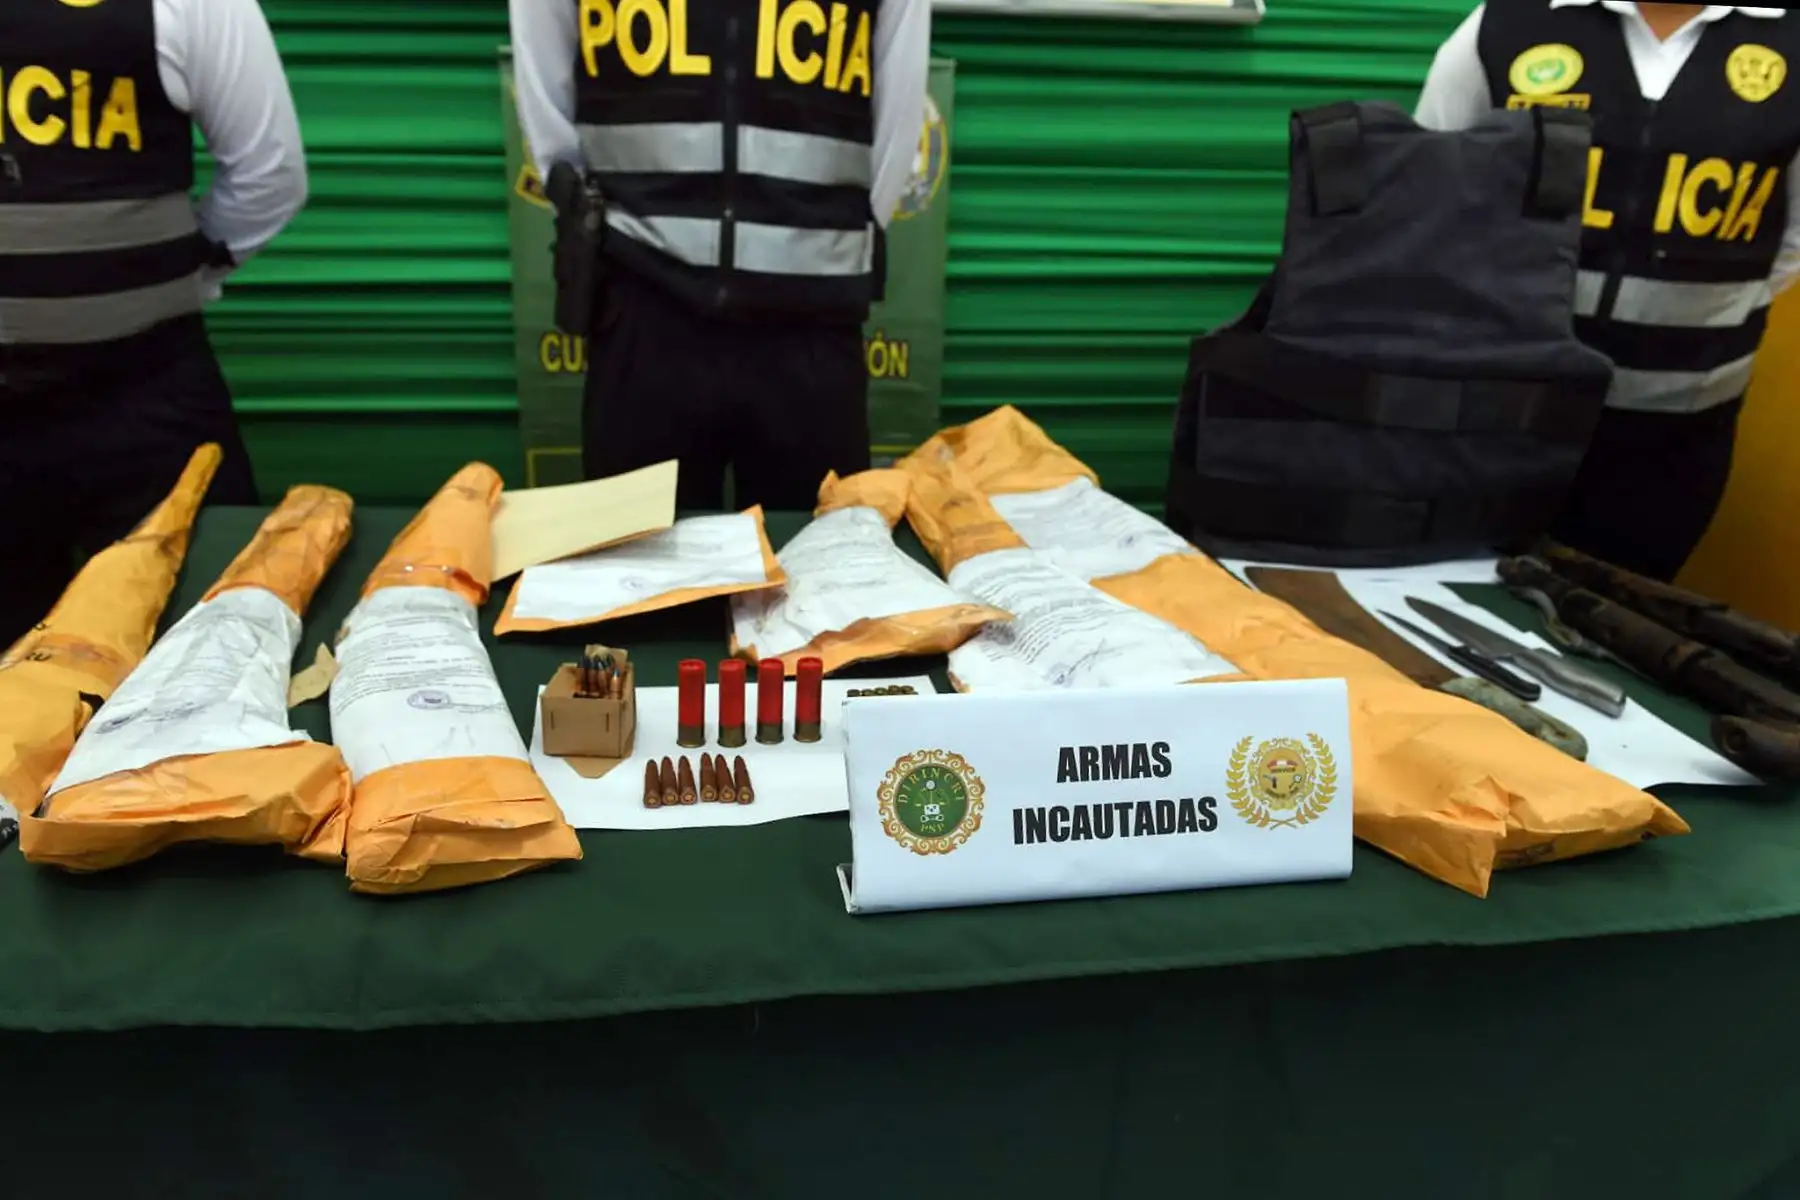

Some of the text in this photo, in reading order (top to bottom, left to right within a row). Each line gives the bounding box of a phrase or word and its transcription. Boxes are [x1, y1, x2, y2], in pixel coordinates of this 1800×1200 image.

[541, 333, 588, 373] CU
[863, 331, 908, 378] ÓN
[1056, 741, 1172, 783] ARMAS
[1013, 796, 1218, 845] INCAUTADAS
